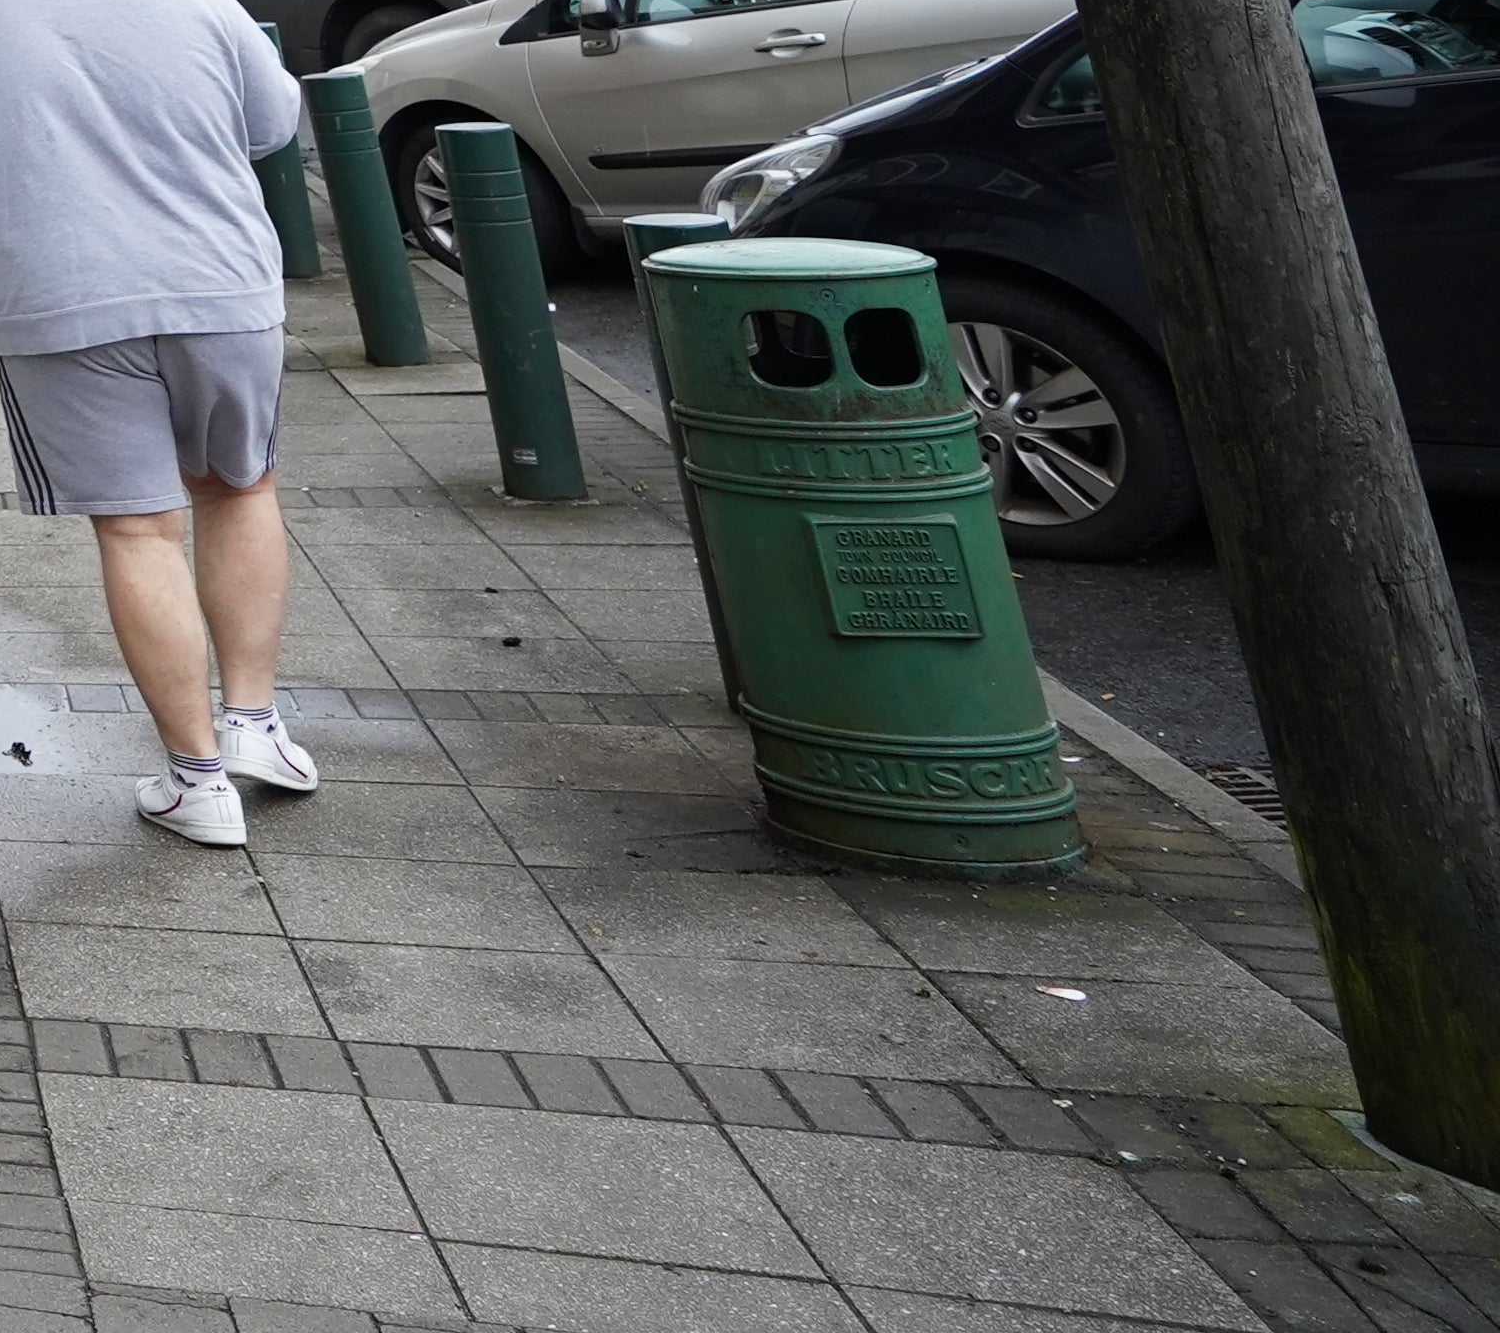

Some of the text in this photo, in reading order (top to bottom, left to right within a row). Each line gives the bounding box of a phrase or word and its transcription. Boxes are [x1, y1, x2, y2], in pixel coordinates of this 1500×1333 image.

[756, 440, 962, 480] LITTER
[836, 529, 932, 547] GRANARD
[836, 548, 944, 563] TOWN COUNCIL
[837, 566, 960, 585] COMHAIRLE
[803, 751, 1060, 799] BRUSCAR
